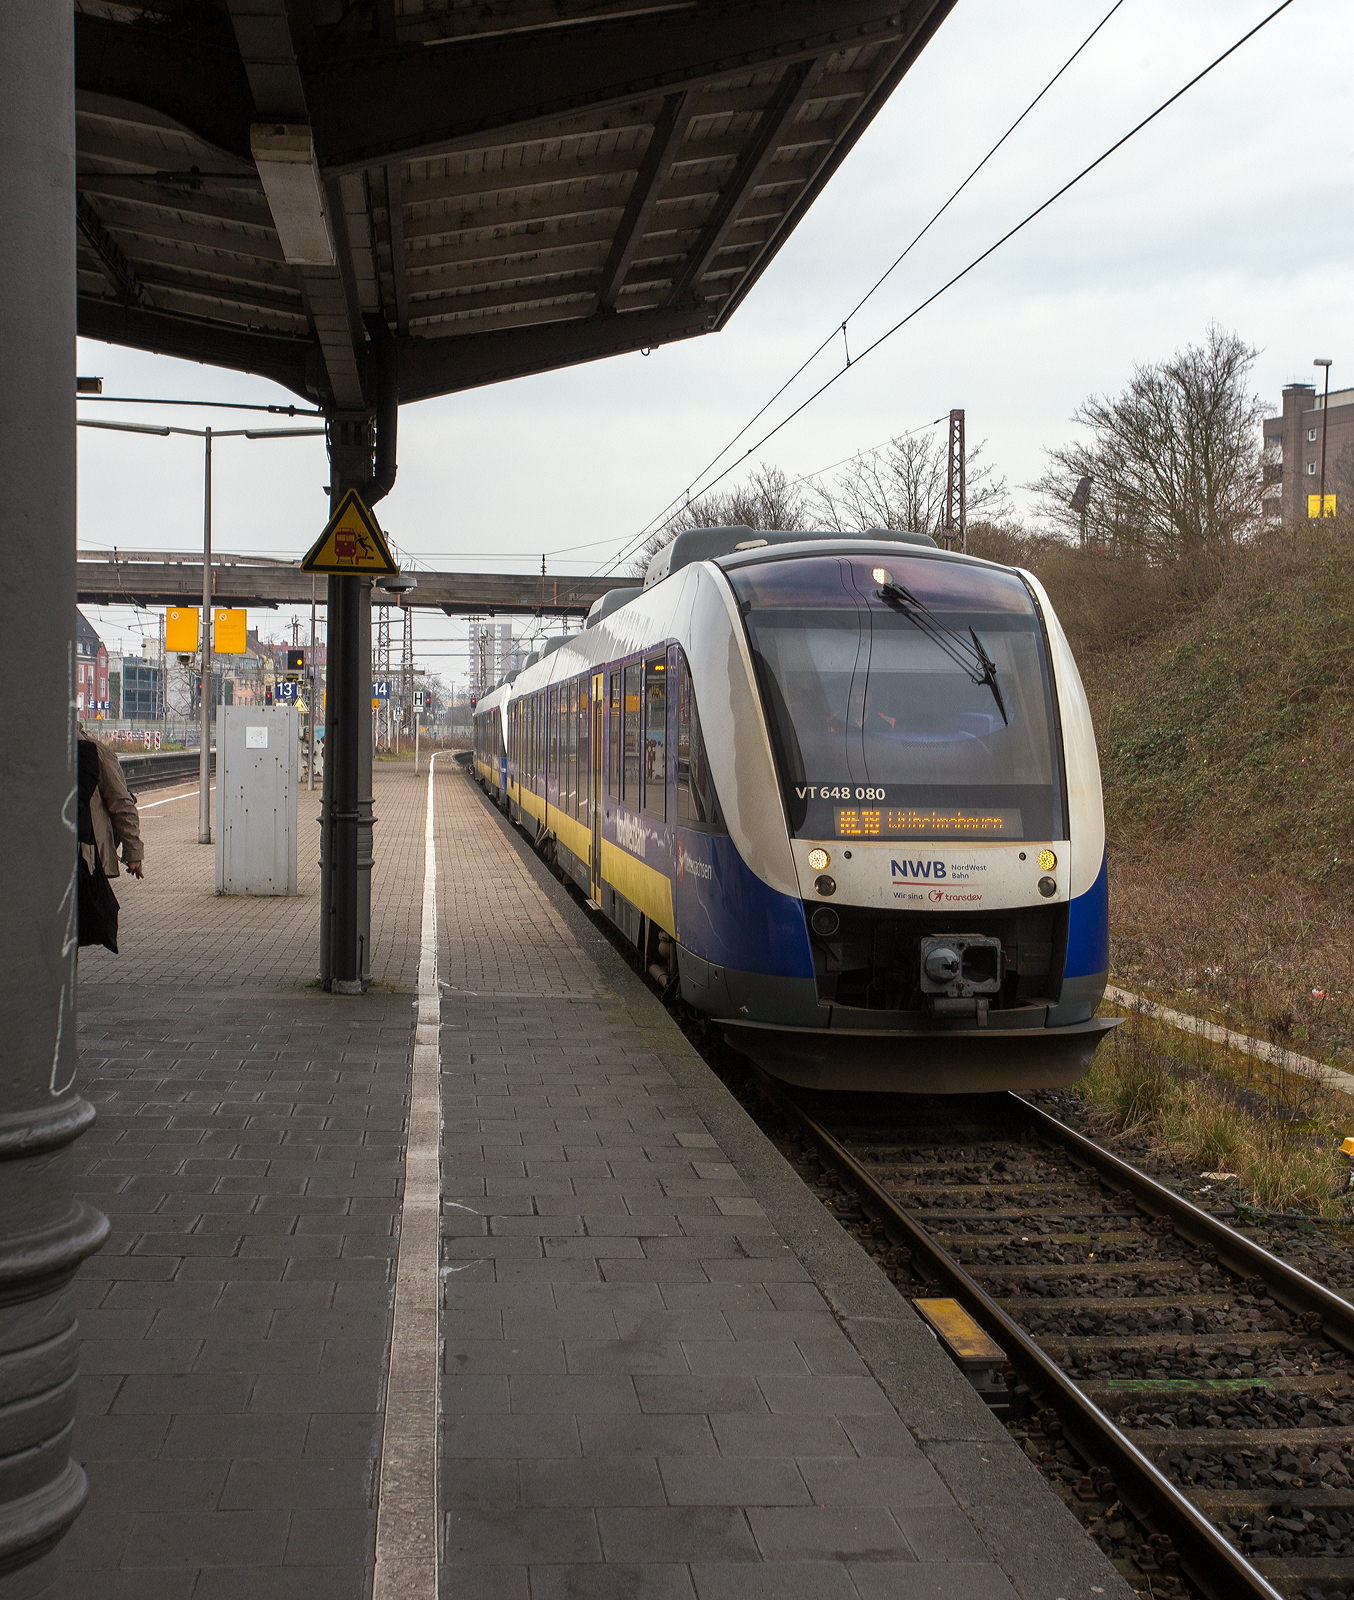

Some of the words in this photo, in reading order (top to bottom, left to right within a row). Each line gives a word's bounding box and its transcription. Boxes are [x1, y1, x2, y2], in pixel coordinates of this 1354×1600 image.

[277, 682, 292, 696] 13
[372, 682, 387, 696] 14
[414, 692, 423, 705] H
[795, 786, 817, 799] VT
[820, 786, 851, 799] 648
[855, 787, 886, 800] 080
[890, 860, 947, 878] NWB
[908, 892, 923, 900] sind
[945, 893, 983, 901] transdev
